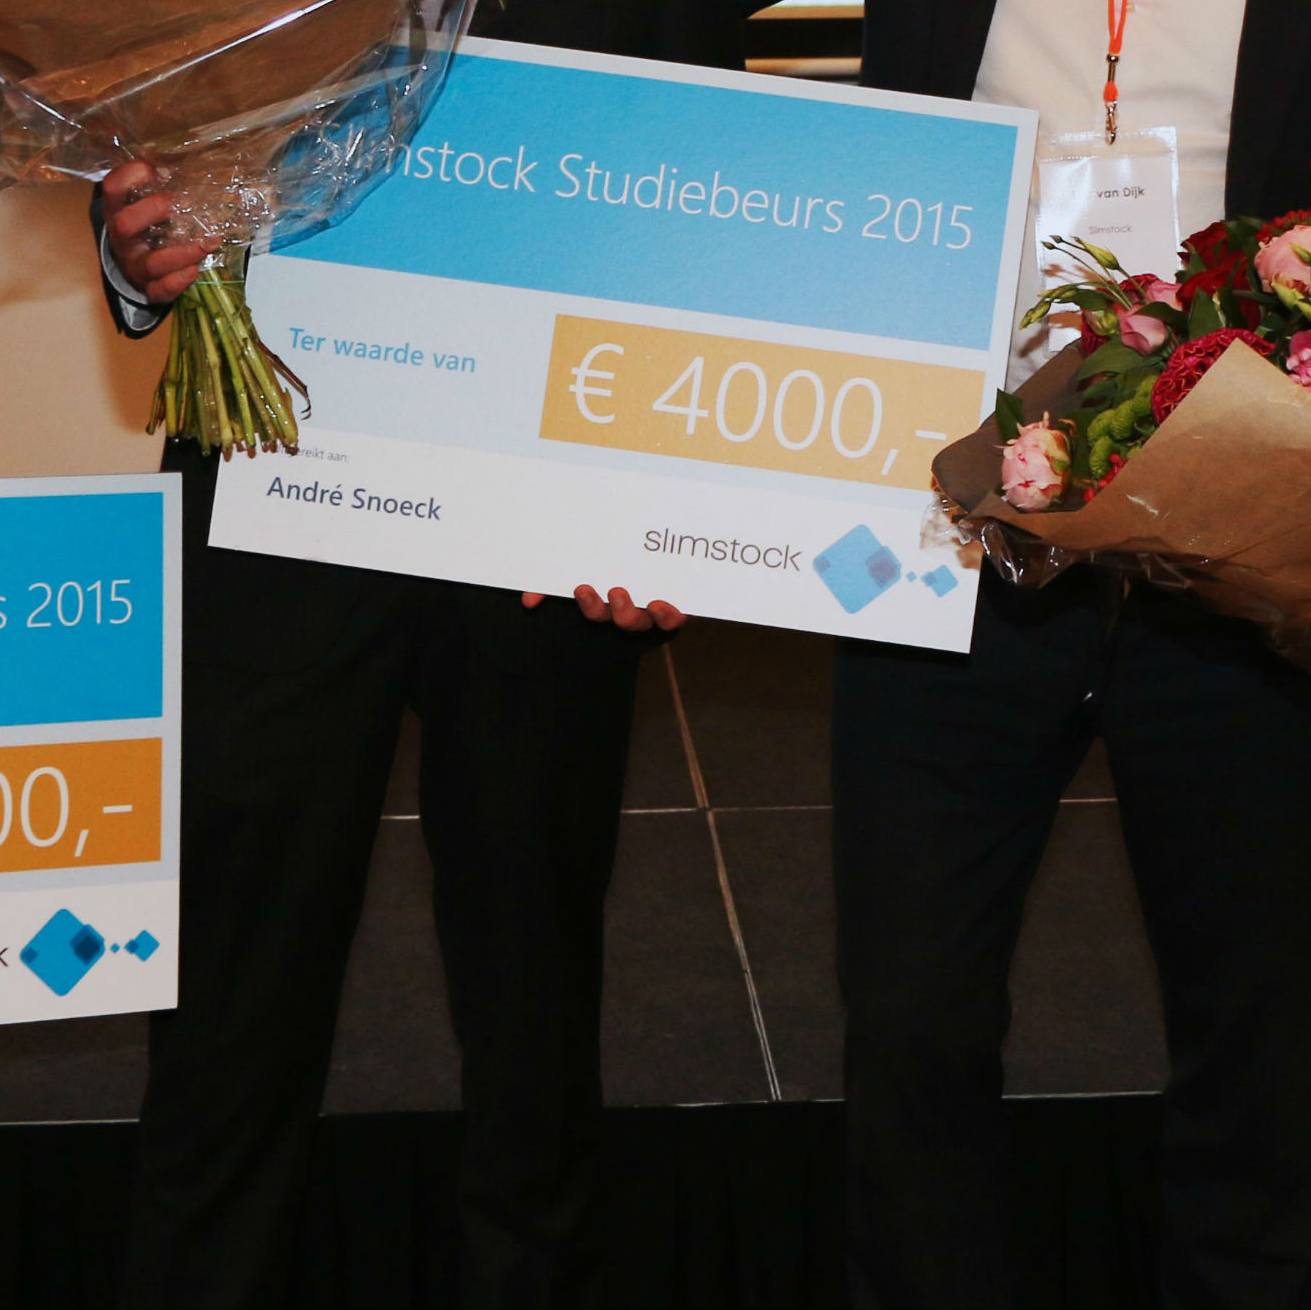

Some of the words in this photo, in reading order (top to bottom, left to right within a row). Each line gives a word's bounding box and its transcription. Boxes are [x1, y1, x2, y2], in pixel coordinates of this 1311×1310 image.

[554, 151, 846, 236] Studiebeurs
[861, 193, 974, 250] 2015
[1097, 189, 1119, 199] van
[1123, 186, 1145, 199] Dijk
[289, 327, 326, 352] Ter
[333, 340, 424, 366] waarde
[432, 352, 476, 373] van
[568, 342, 625, 425] €
[652, 353, 948, 476] 4000,-
[266, 476, 343, 507] André
[351, 487, 441, 521] Snoeck
[643, 527, 802, 572] slimstock
[26, 578, 133, 628] 2015
